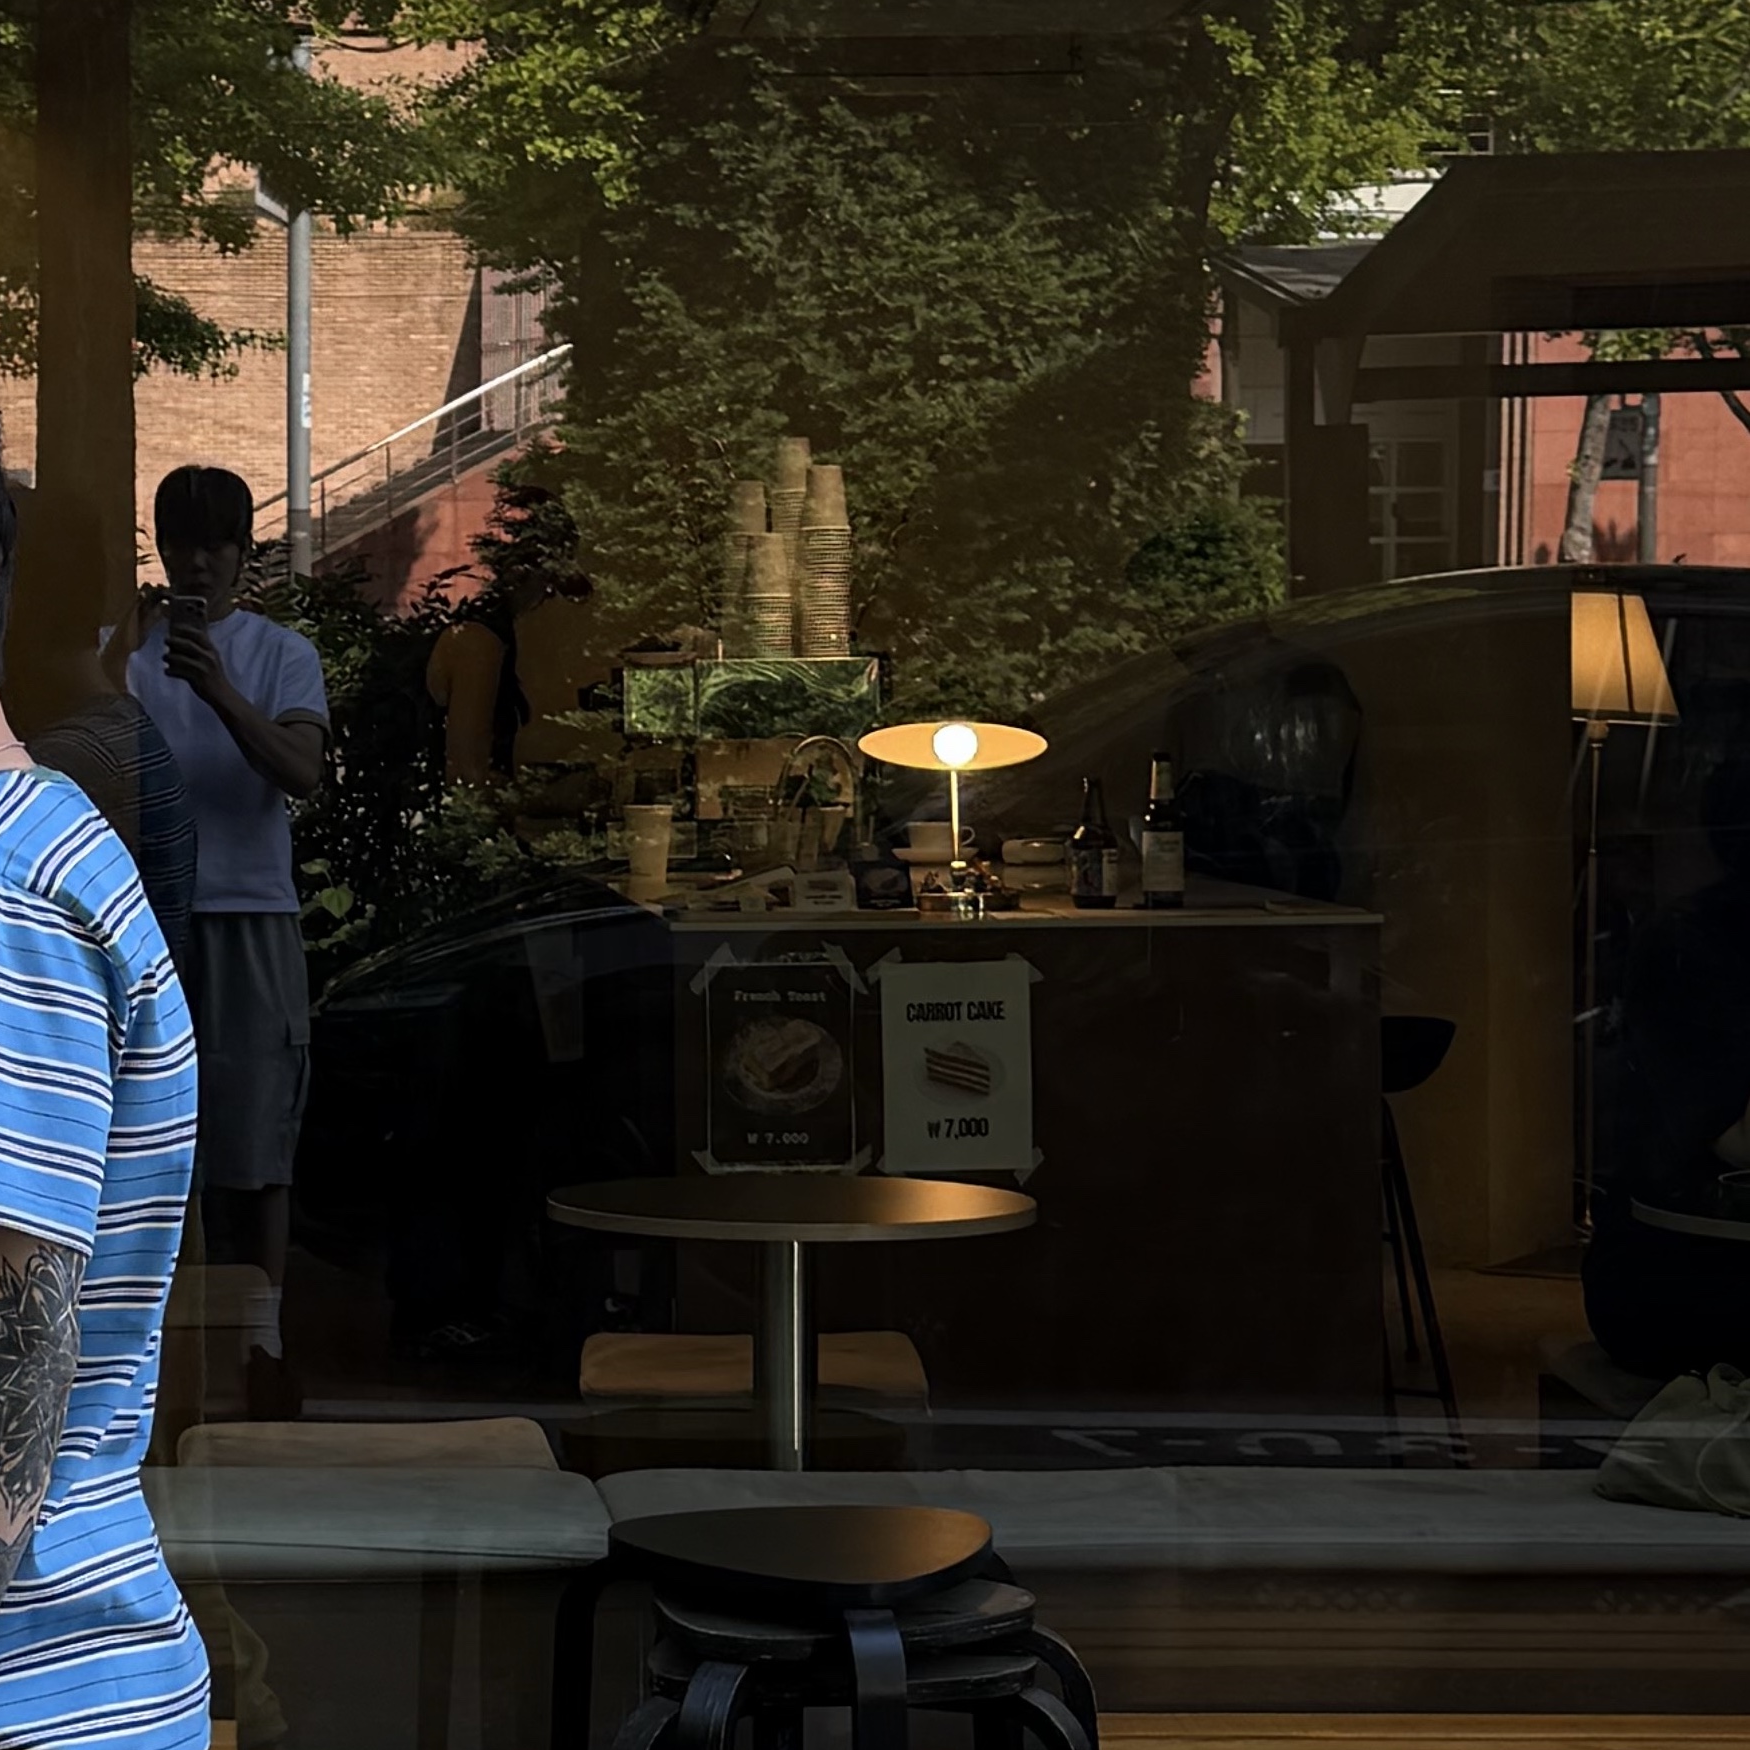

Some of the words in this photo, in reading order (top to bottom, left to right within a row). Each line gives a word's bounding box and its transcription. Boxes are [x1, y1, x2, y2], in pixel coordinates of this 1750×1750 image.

[906, 1001, 963, 1023] CARROT
[967, 1000, 1007, 1021] CAKE
[944, 1117, 989, 1141] 7,000
